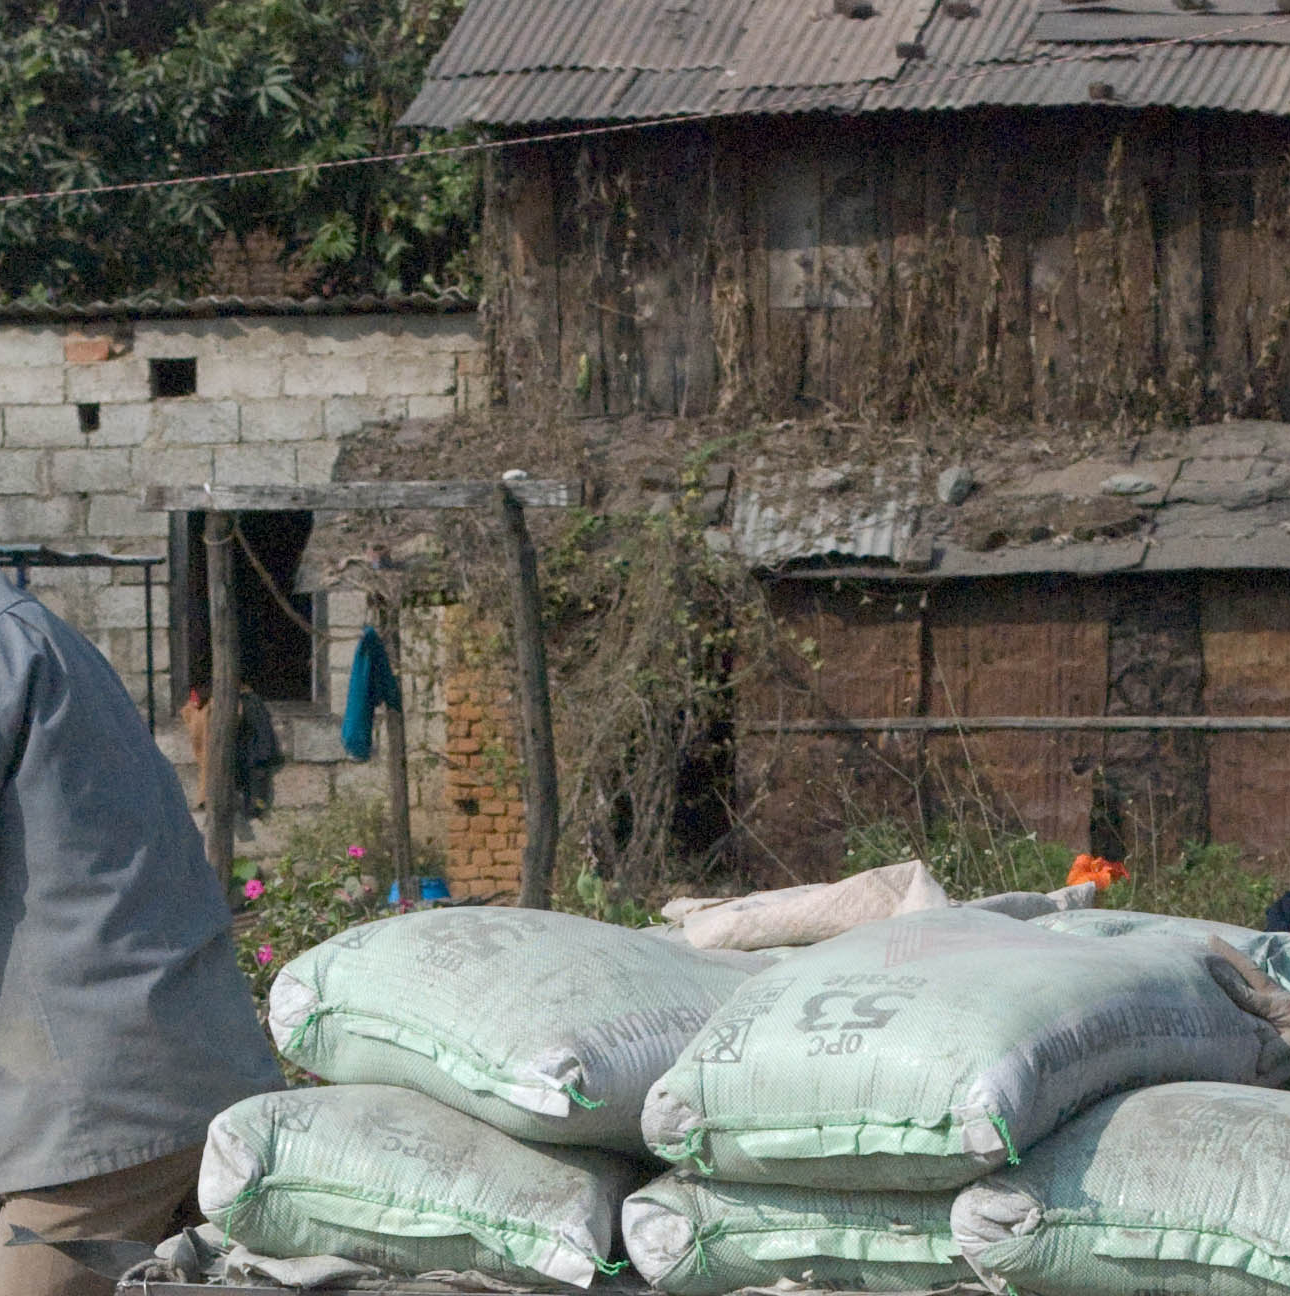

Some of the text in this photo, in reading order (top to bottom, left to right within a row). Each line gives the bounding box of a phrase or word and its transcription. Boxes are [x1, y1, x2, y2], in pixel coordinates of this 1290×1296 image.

[821, 973, 928, 990] Grade
[795, 990, 916, 1034] 53
[807, 1033, 863, 1057] OPC
